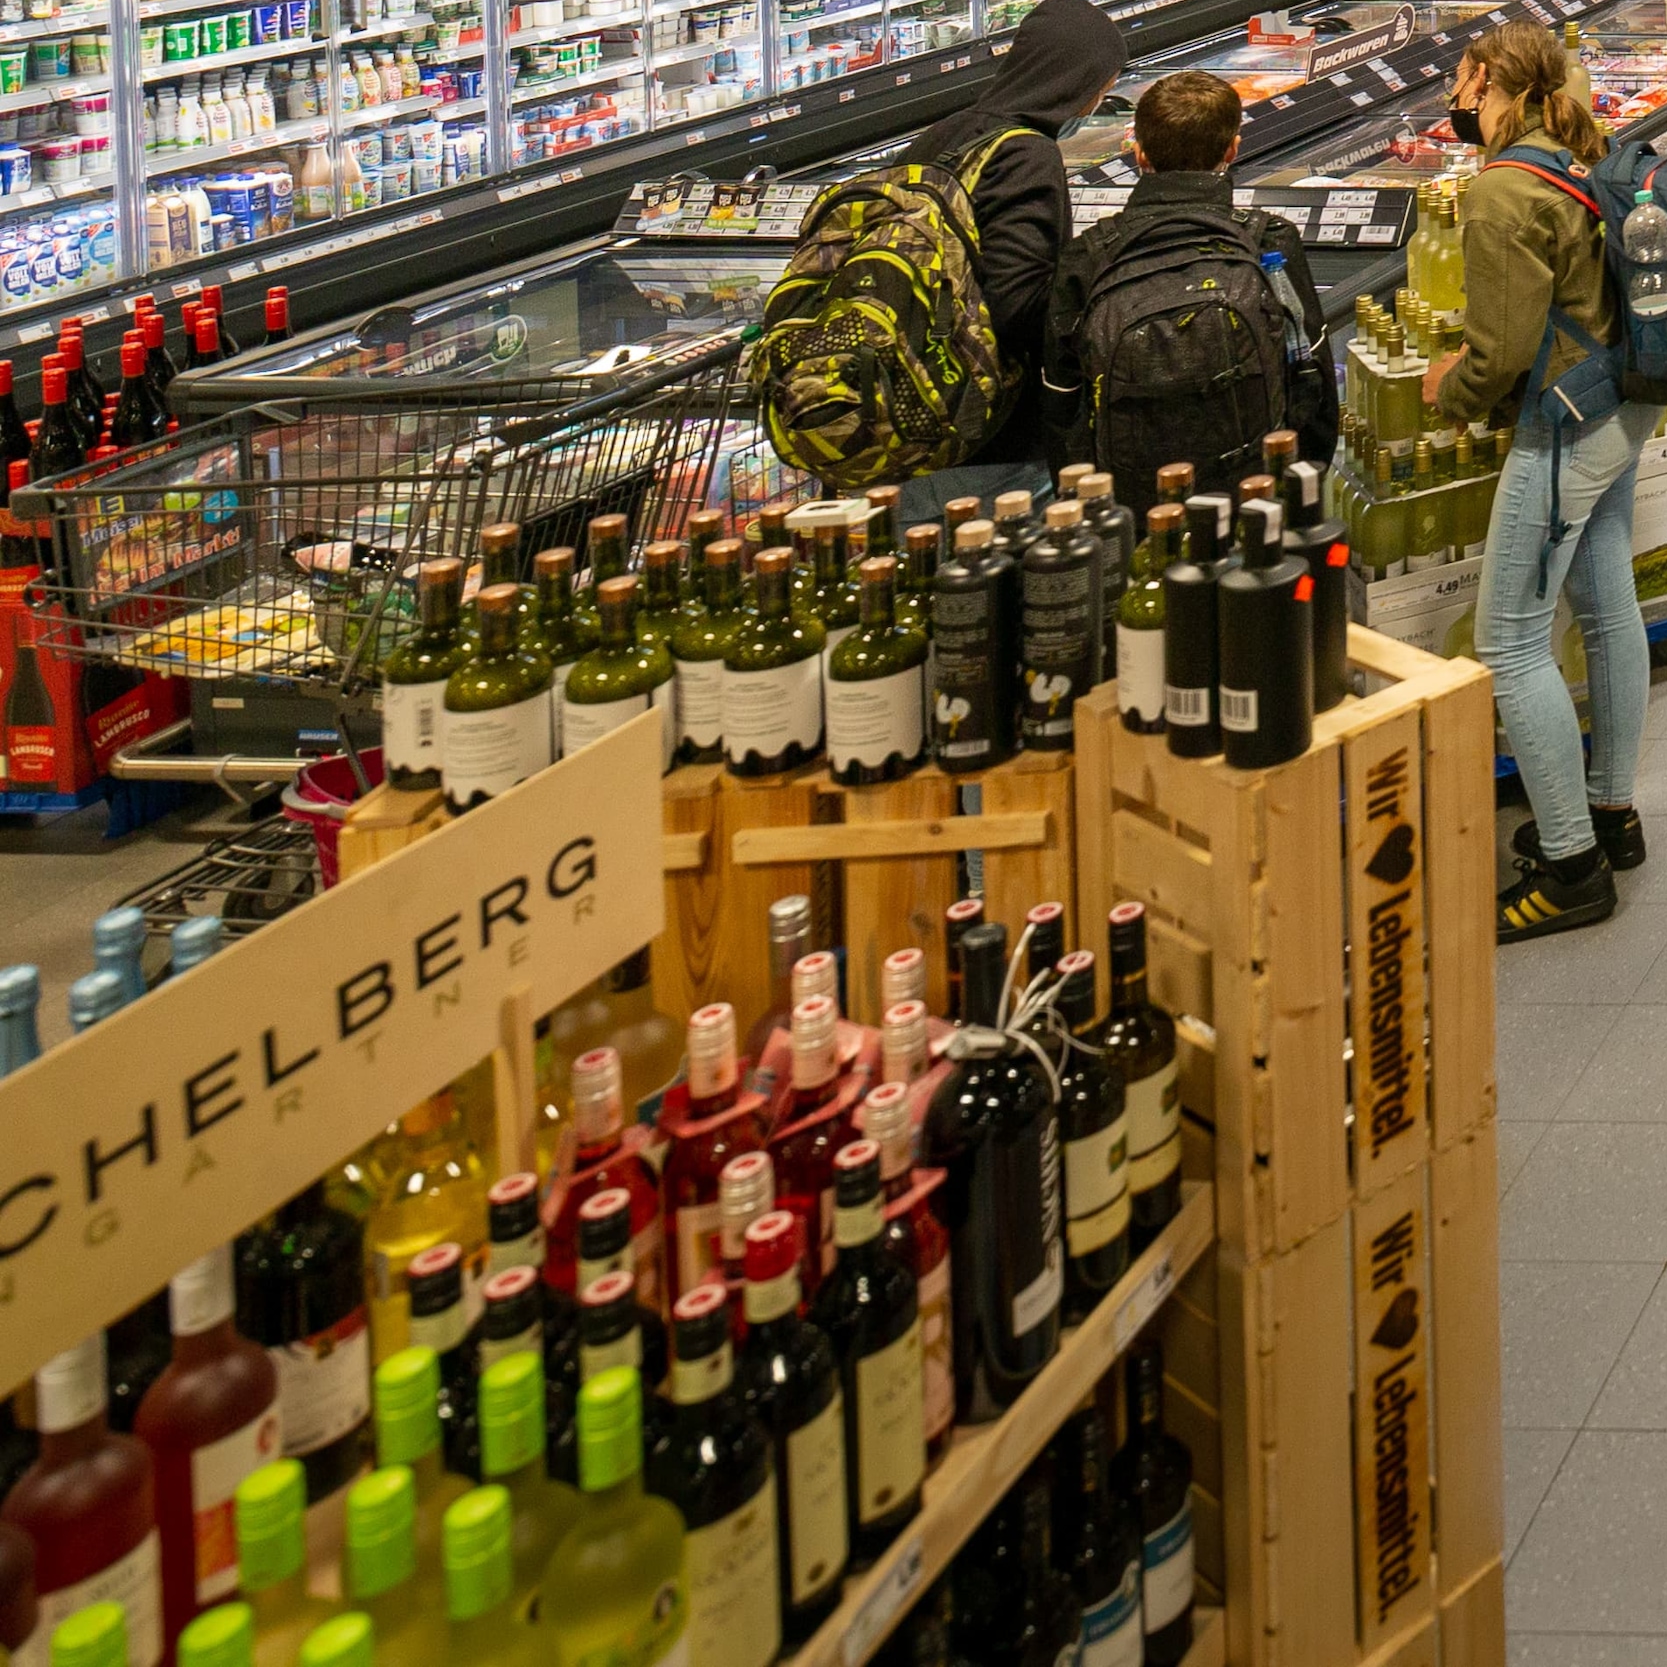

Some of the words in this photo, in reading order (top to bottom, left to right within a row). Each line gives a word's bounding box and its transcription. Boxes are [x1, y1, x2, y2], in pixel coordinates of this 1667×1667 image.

[1313, 34, 1390, 72] Backwaren
[1635, 489, 1667, 501] AYBACH
[1436, 580, 1459, 596] 4.49
[1393, 628, 1436, 643] AYBACH
[94, 709, 151, 747] LAMBRUSCO
[1365, 748, 1411, 824] Wir
[1366, 889, 1415, 1162] Lebensmittel.
[1371, 1209, 1414, 1294] Wir
[1374, 1350, 1424, 1625] Lebensmittel.
